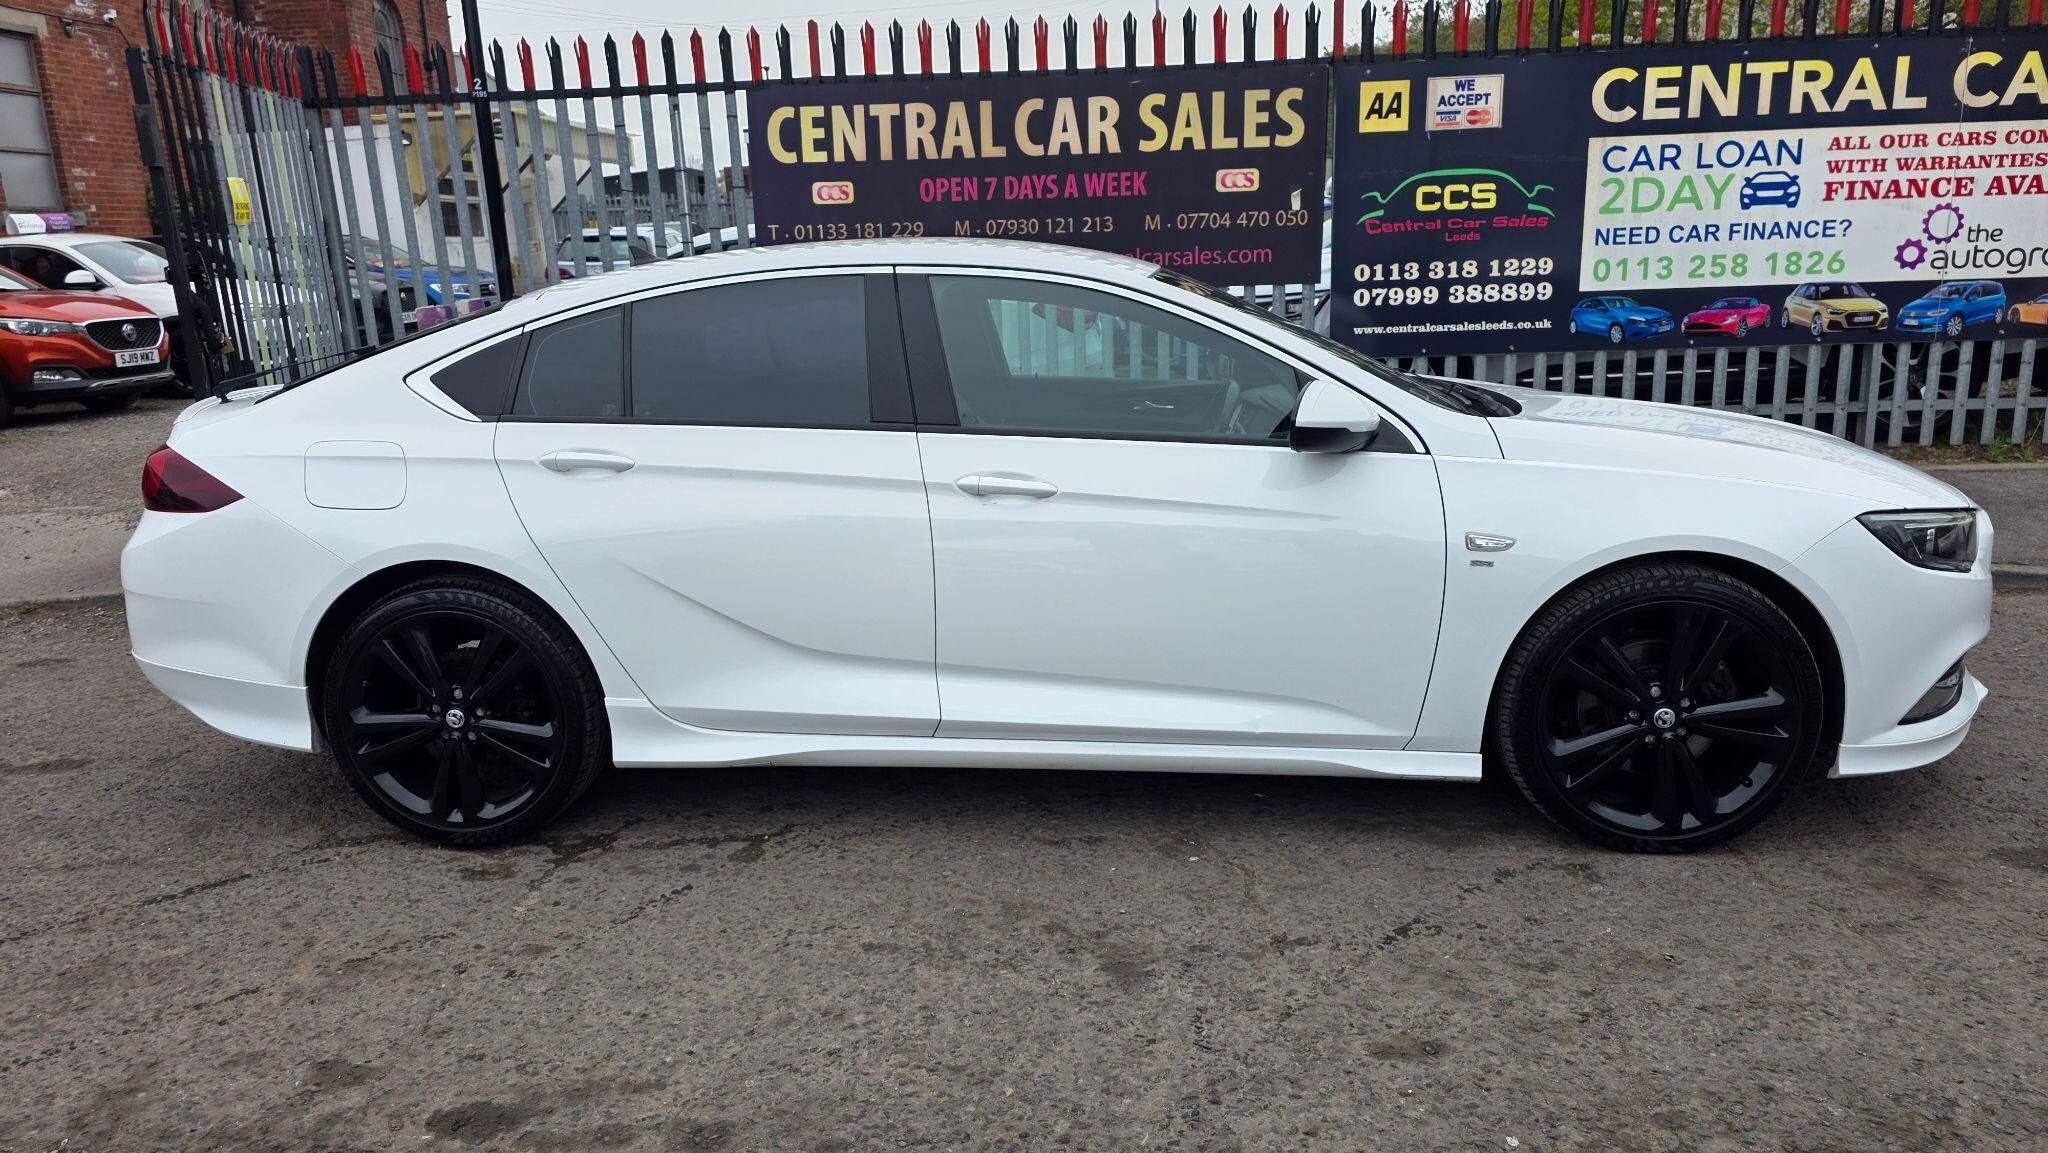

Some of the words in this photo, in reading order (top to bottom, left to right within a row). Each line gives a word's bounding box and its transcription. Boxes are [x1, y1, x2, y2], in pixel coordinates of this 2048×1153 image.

[473, 78, 482, 90] 2
[1455, 79, 1475, 92] WE
[1592, 56, 1927, 123] CENTRAL
[1954, 50, 2048, 108] CA
[1365, 92, 1402, 120] AA
[1437, 93, 1491, 107] ACCEPT
[767, 101, 1006, 164] CENTRAL
[1014, 96, 1122, 157] CAR
[1138, 87, 1305, 153] SALES
[1827, 136, 1871, 151] ALL
[1879, 133, 1929, 149] OUR
[1937, 130, 1997, 147] CARS
[1602, 143, 1682, 173] CAR
[1696, 138, 1804, 169] LOAN
[1826, 158, 1888, 174] WITH
[1896, 152, 2048, 172] WARRANTIES
[920, 177, 978, 202] OPEN
[985, 177, 998, 200] 7
[1004, 174, 1059, 200] DAYS
[1064, 173, 1079, 198] A
[1084, 171, 1147, 198] WEEK
[1415, 182, 1497, 212] CCS
[1598, 173, 1737, 215] 2DAY
[1822, 176, 1975, 201] FINANCE
[794, 223, 848, 240] 01133
[854, 222, 884, 239] 181
[891, 221, 924, 237] 229
[986, 218, 1039, 236] 07930
[1046, 217, 1074, 234] 121
[1082, 216, 1114, 233] 213
[1176, 212, 1231, 229] 07704
[1236, 211, 1270, 228] 470
[1275, 209, 1308, 226] 050
[1365, 218, 1441, 235] Central
[1447, 217, 1487, 229] Car
[1492, 214, 1549, 228] Sales
[1445, 231, 1481, 242] Leeds
[1595, 226, 1661, 246] NEED
[1668, 223, 1721, 244] CAR
[1728, 218, 1853, 242] FINANCE?
[1967, 224, 2004, 243] the
[1354, 262, 1420, 282] 0113
[1428, 259, 1478, 279] 318
[1489, 257, 1554, 277] 1229
[1592, 255, 1674, 283] 0113
[1687, 253, 1749, 280] 258
[1765, 250, 1846, 277] 1826
[1353, 285, 1439, 307] 07999
[1448, 281, 1553, 303] 388899
[1353, 318, 1552, 334] www.centralcarsalesleeds.co.uk
[120, 353, 138, 364] SJ19
